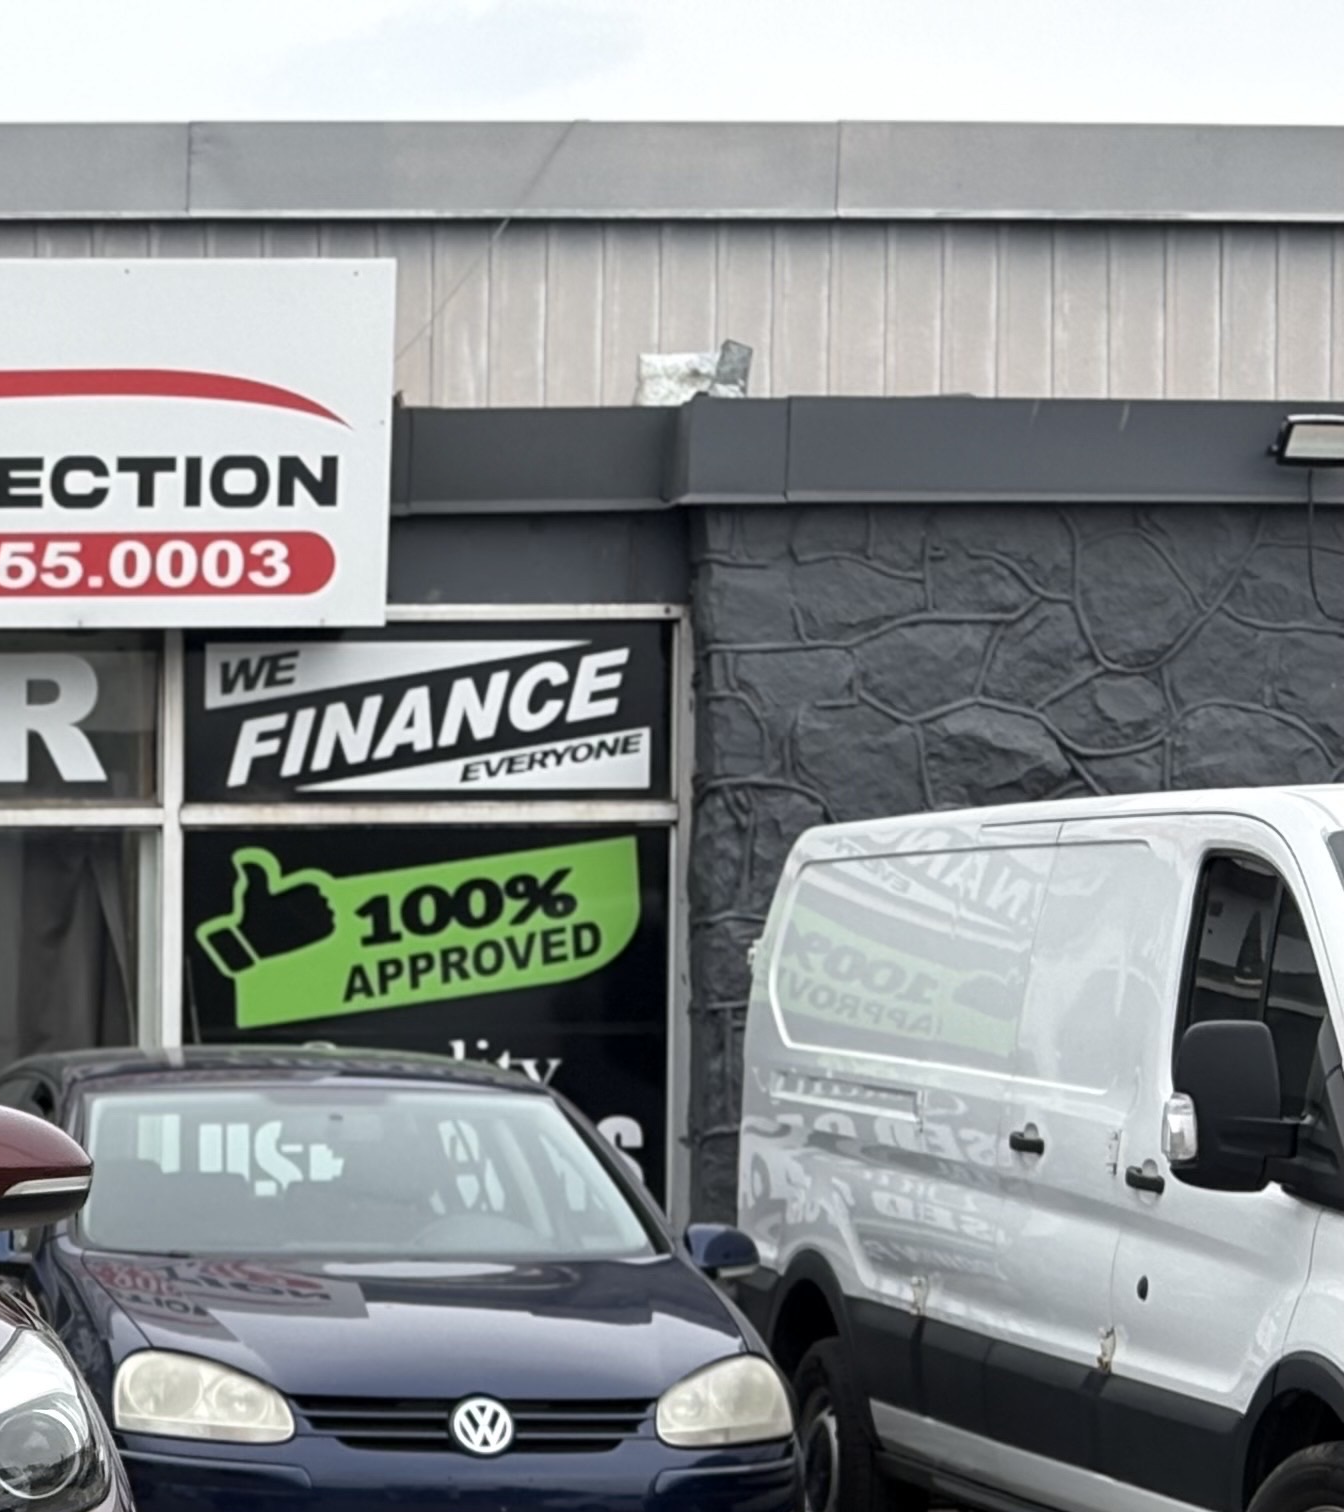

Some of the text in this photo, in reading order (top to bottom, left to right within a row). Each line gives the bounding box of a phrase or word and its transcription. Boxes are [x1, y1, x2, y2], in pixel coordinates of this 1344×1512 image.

[218, 651, 300, 696] WE
[226, 646, 631, 789] FINANCE
[460, 733, 643, 784] EVERYONE
[354, 867, 579, 947] 100%
[342, 920, 604, 1003] APPROVED
